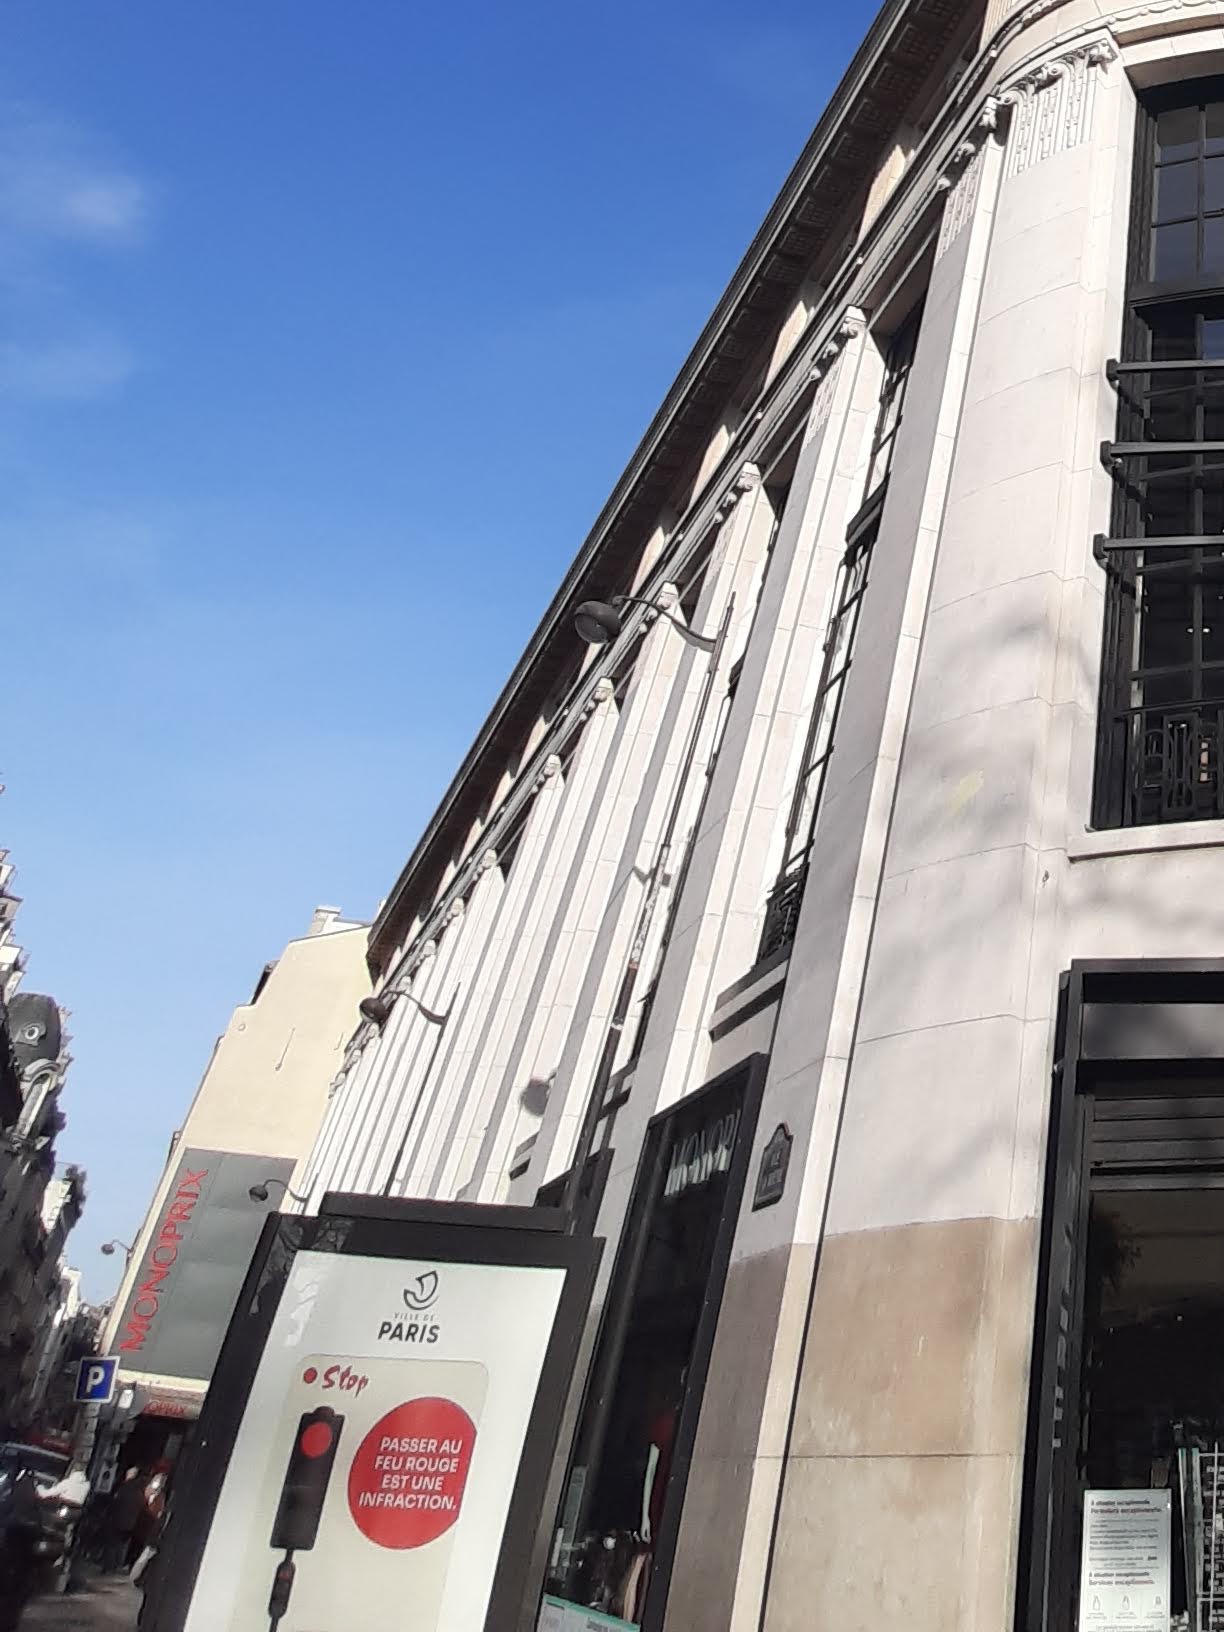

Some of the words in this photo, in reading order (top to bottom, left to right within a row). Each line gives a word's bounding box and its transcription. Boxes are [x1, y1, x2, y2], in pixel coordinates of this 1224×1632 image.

[119, 1168, 208, 1352] MONOPRIX
[378, 1321, 441, 1343] PARIS
[86, 1366, 105, 1393] P
[322, 1365, 369, 1398] Stop
[380, 1437, 441, 1454] PASSER
[439, 1438, 462, 1454] AU
[375, 1455, 403, 1470] FEU
[405, 1456, 459, 1473] ROUGE
[382, 1474, 409, 1489] EST
[411, 1475, 444, 1491] UNE
[359, 1491, 457, 1510] INFRACTION.
